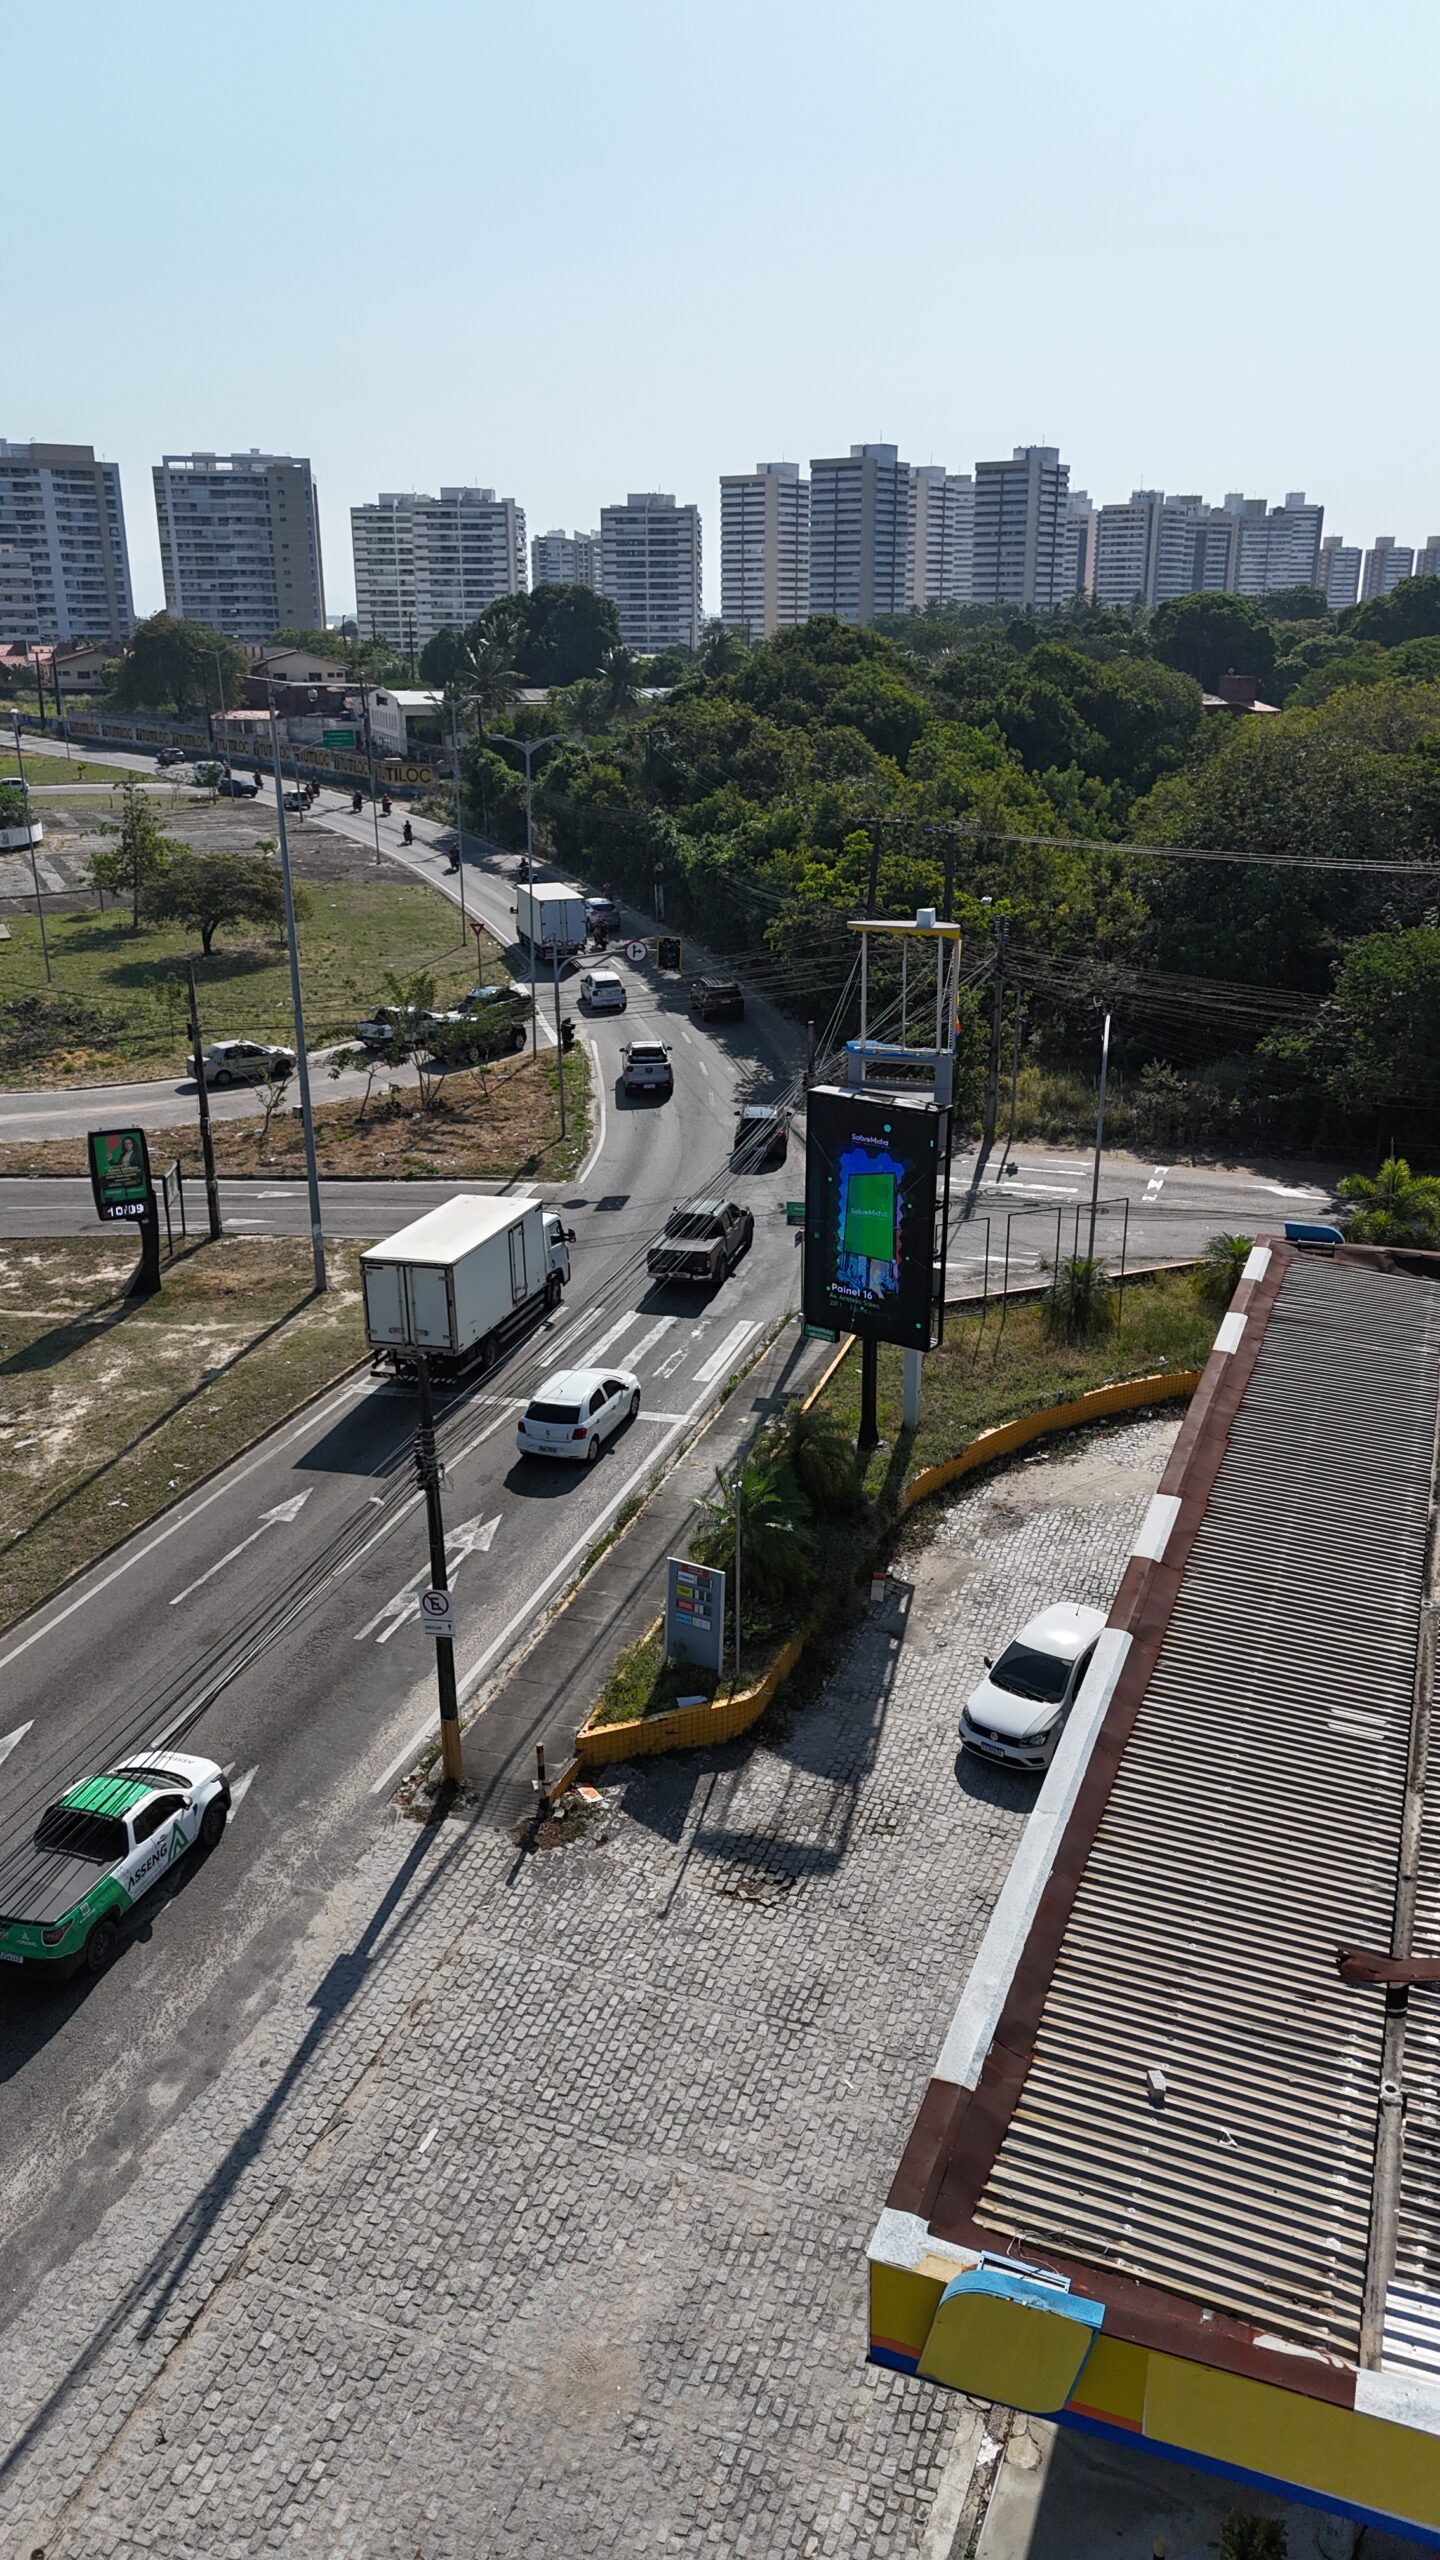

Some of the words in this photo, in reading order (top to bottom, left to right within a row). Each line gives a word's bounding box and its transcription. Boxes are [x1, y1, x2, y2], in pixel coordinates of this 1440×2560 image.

[831, 1283, 860, 1297] Painel
[863, 1290, 873, 1300] 16
[128, 1843, 168, 1892] ASSENG
